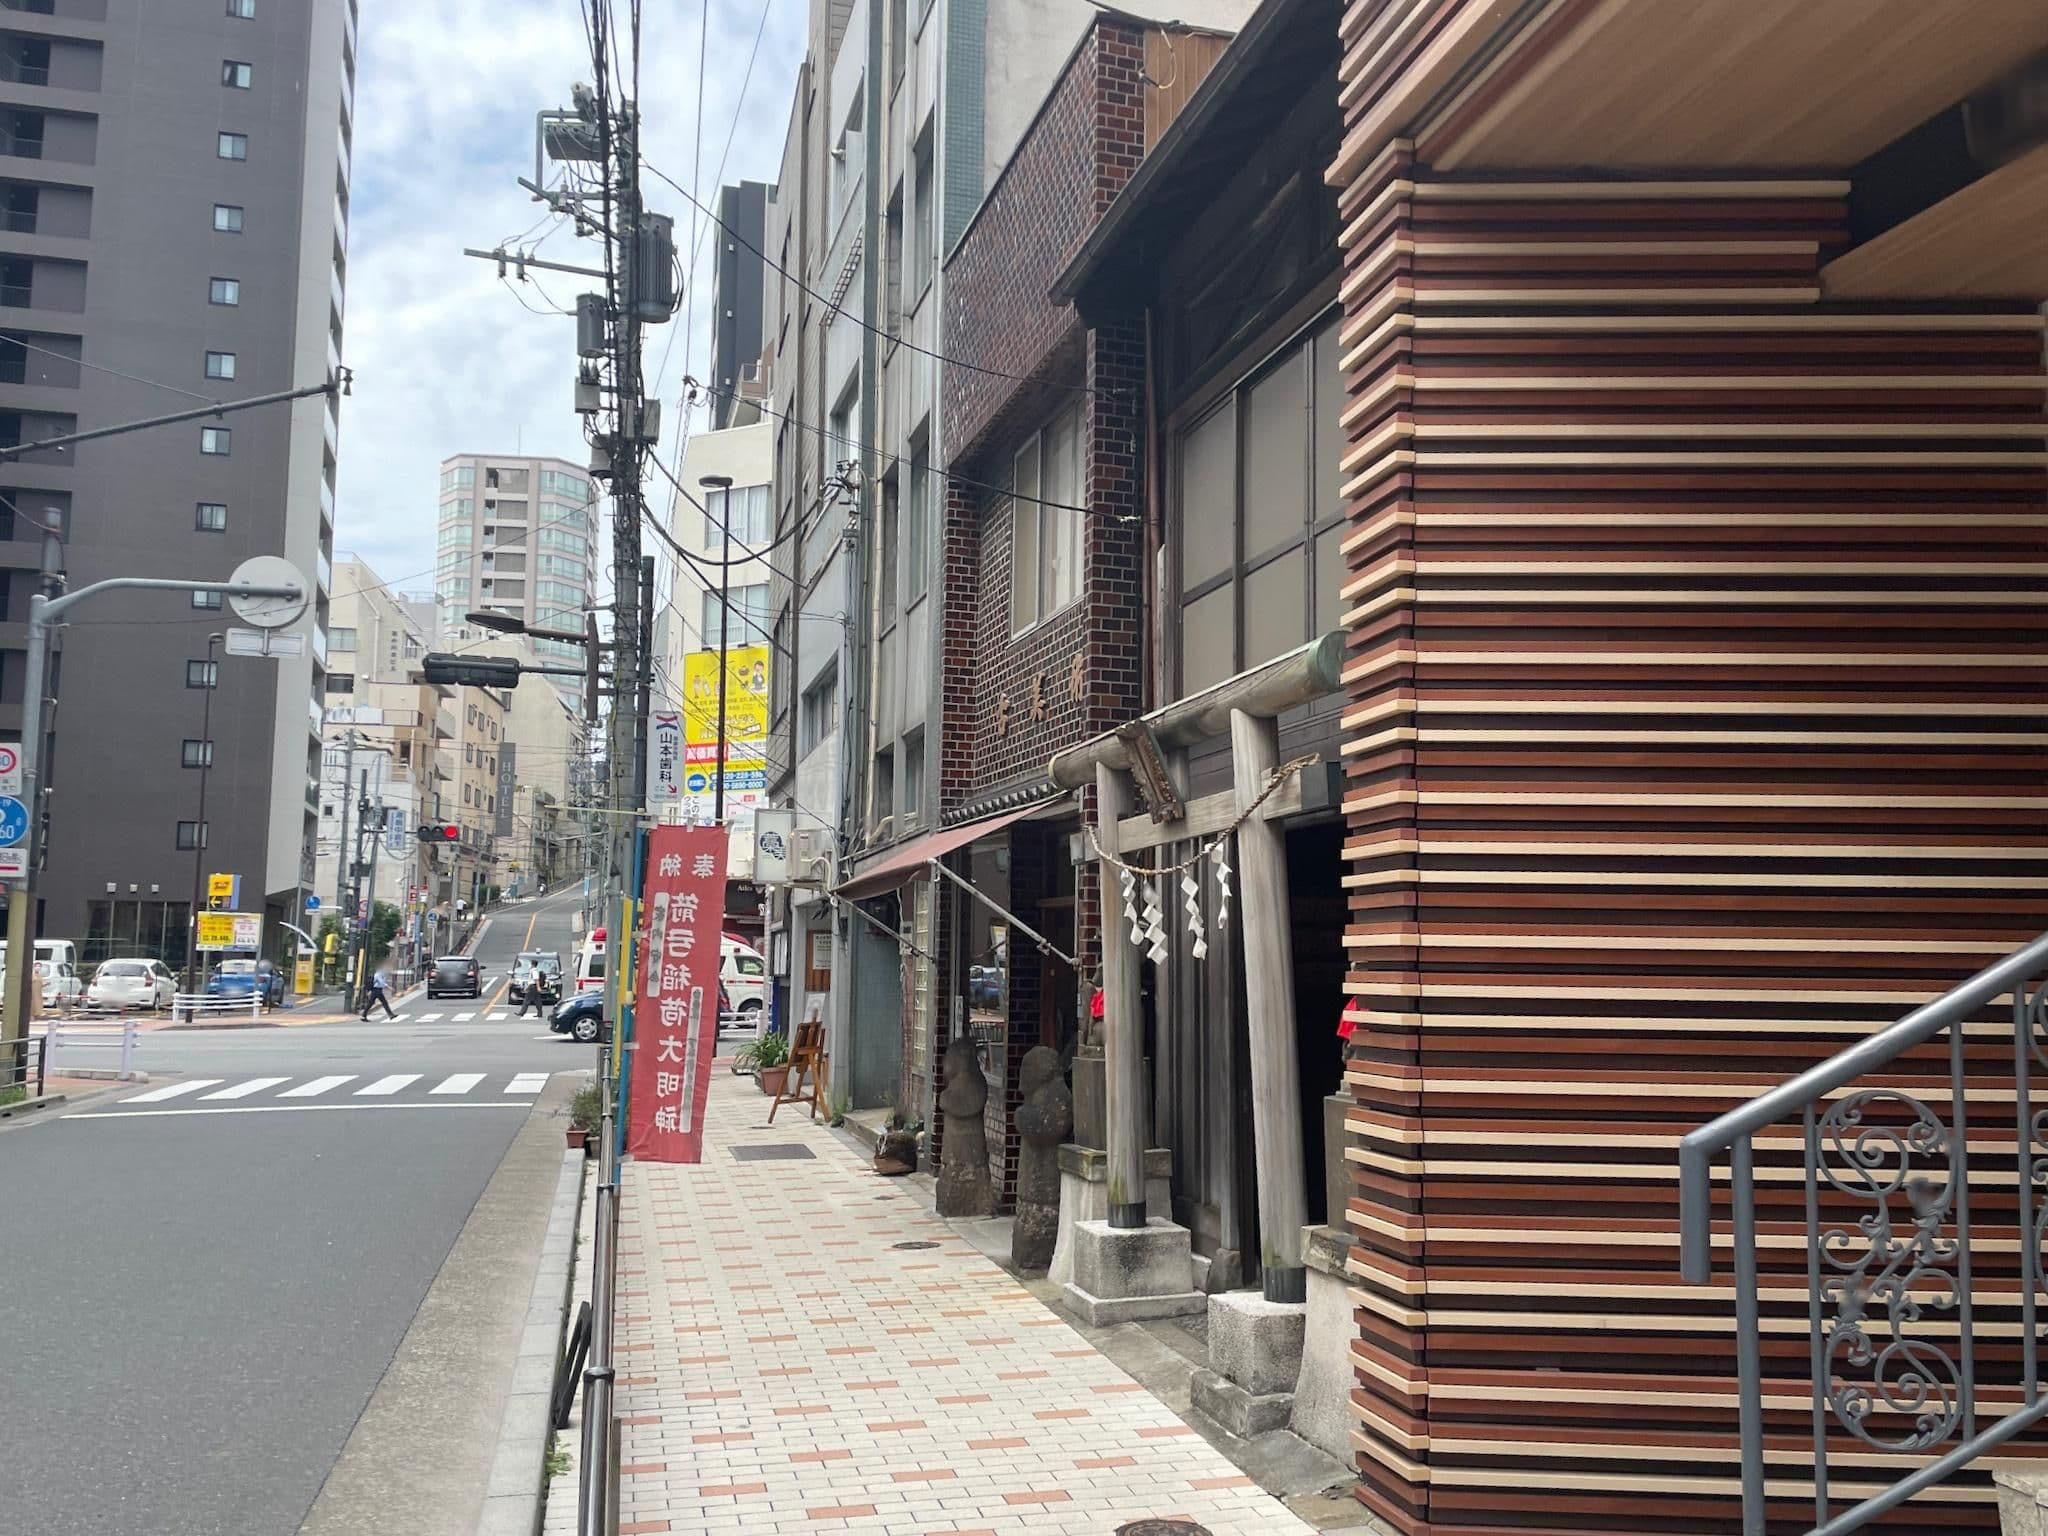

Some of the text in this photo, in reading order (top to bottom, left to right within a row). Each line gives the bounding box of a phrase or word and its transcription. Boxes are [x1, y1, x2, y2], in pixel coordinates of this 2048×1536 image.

[660, 731, 673, 783] 山本歯科
[501, 761, 512, 819] HOTEL
